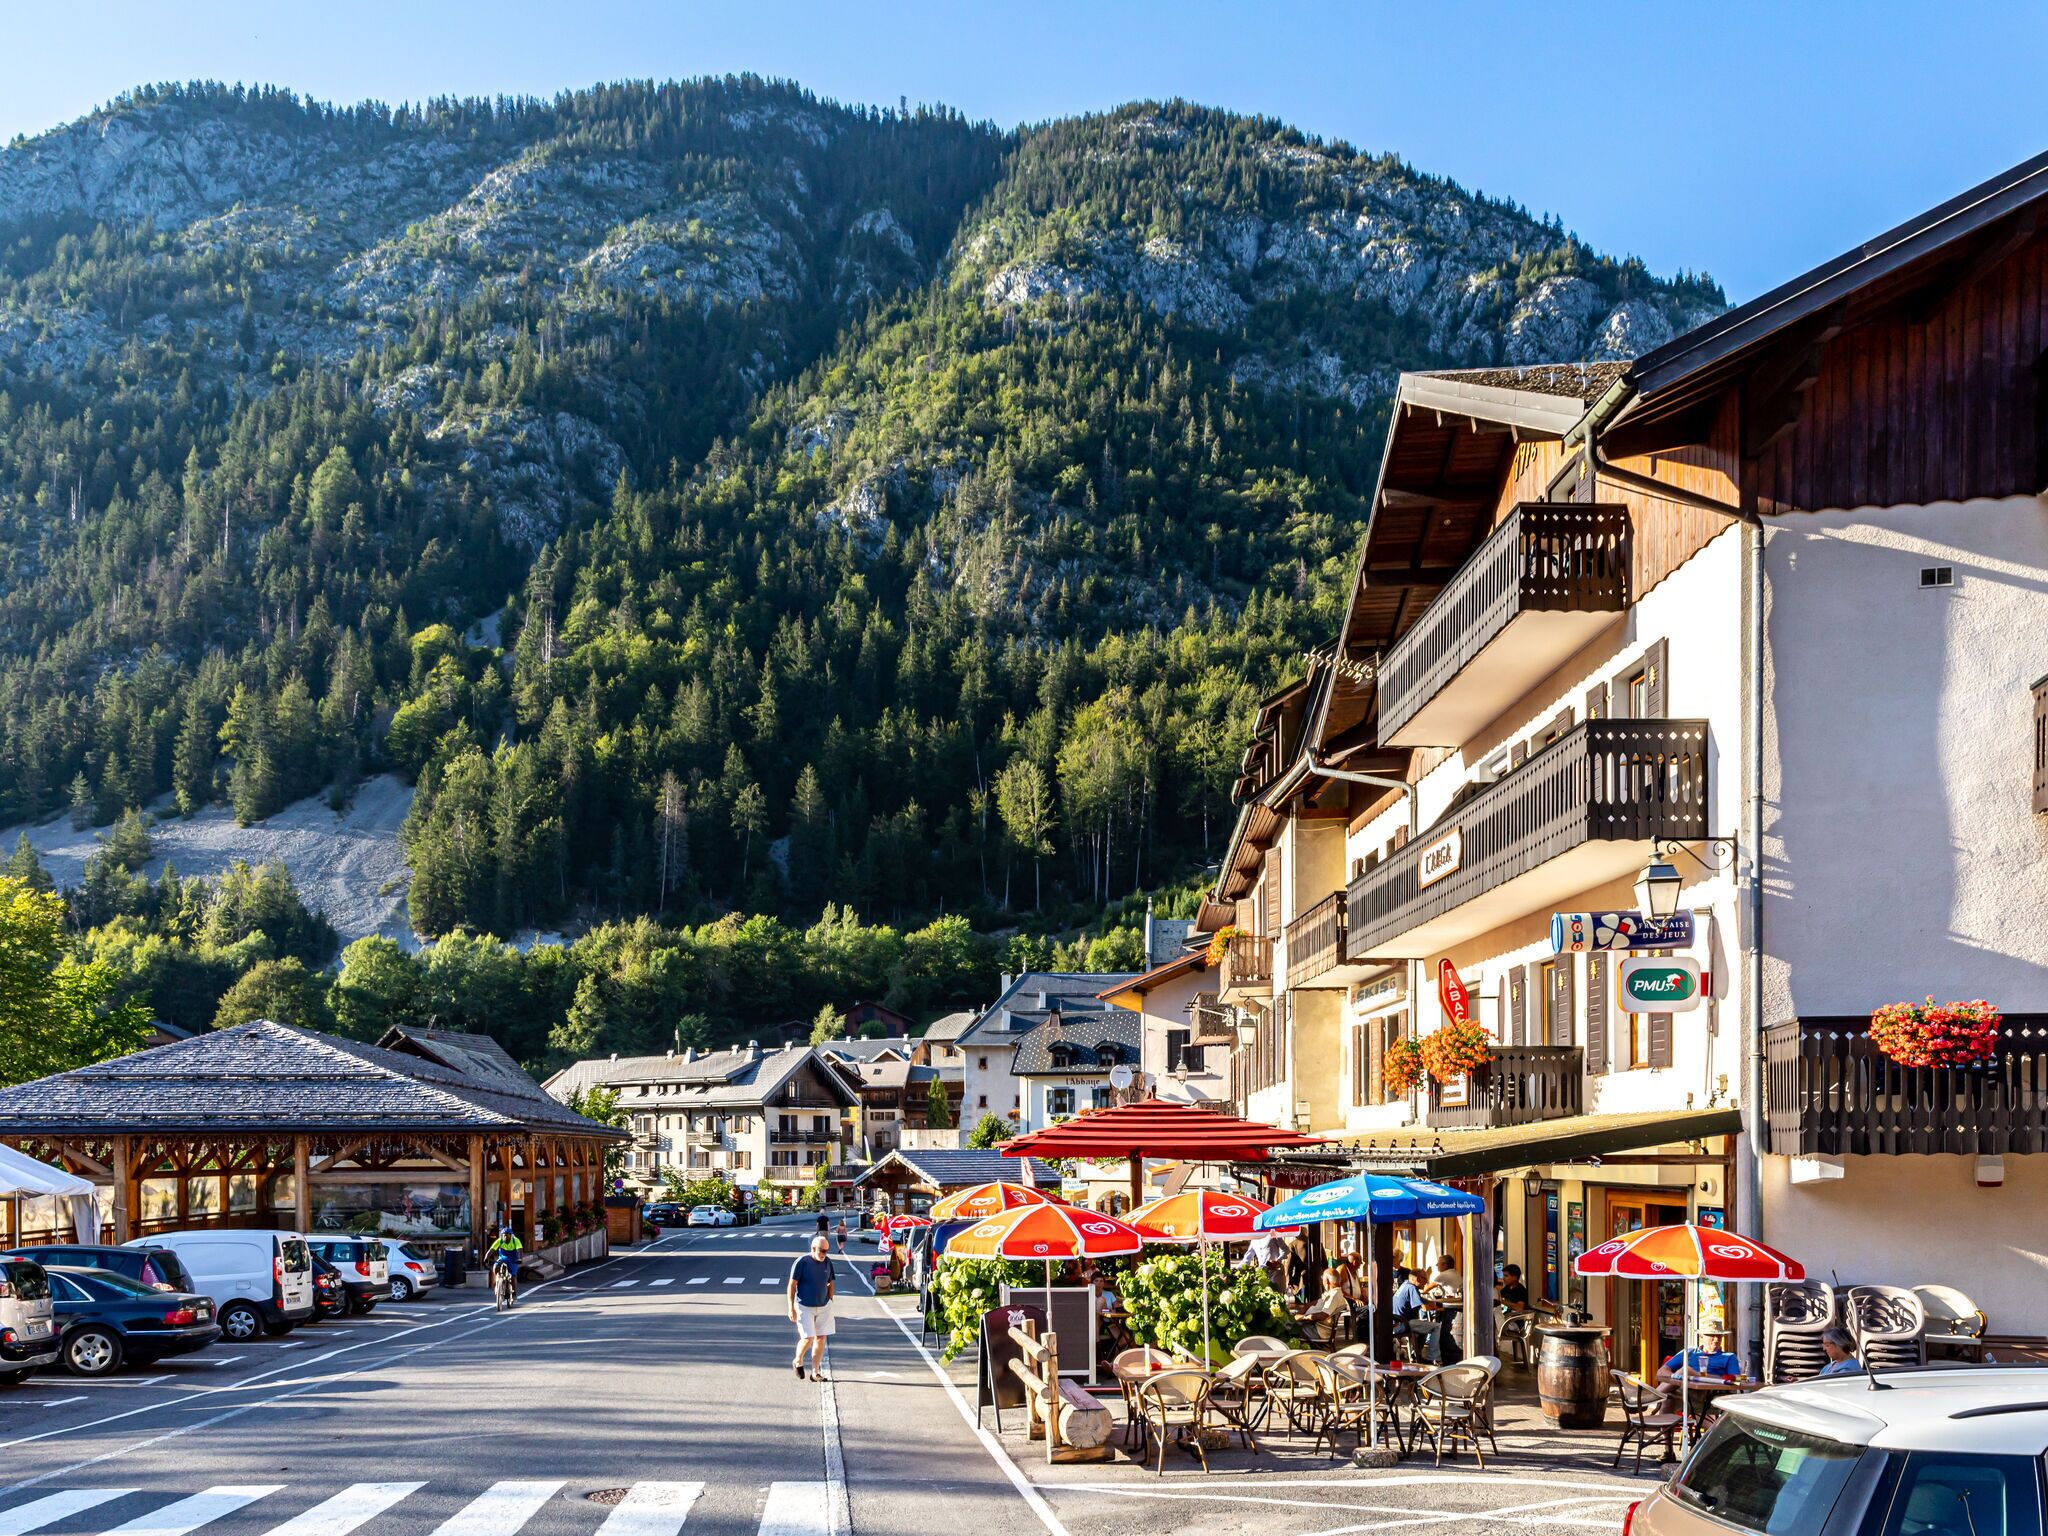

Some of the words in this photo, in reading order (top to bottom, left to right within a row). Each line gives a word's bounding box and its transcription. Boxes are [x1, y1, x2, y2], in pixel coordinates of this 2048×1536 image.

[1663, 931, 1687, 940] JEUX
[1633, 980, 1666, 992] PMU
[1445, 968, 1465, 1023] TABAC
[1065, 1077, 1100, 1088] l'Abbaye
[1275, 1209, 1321, 1223] Naturellement
